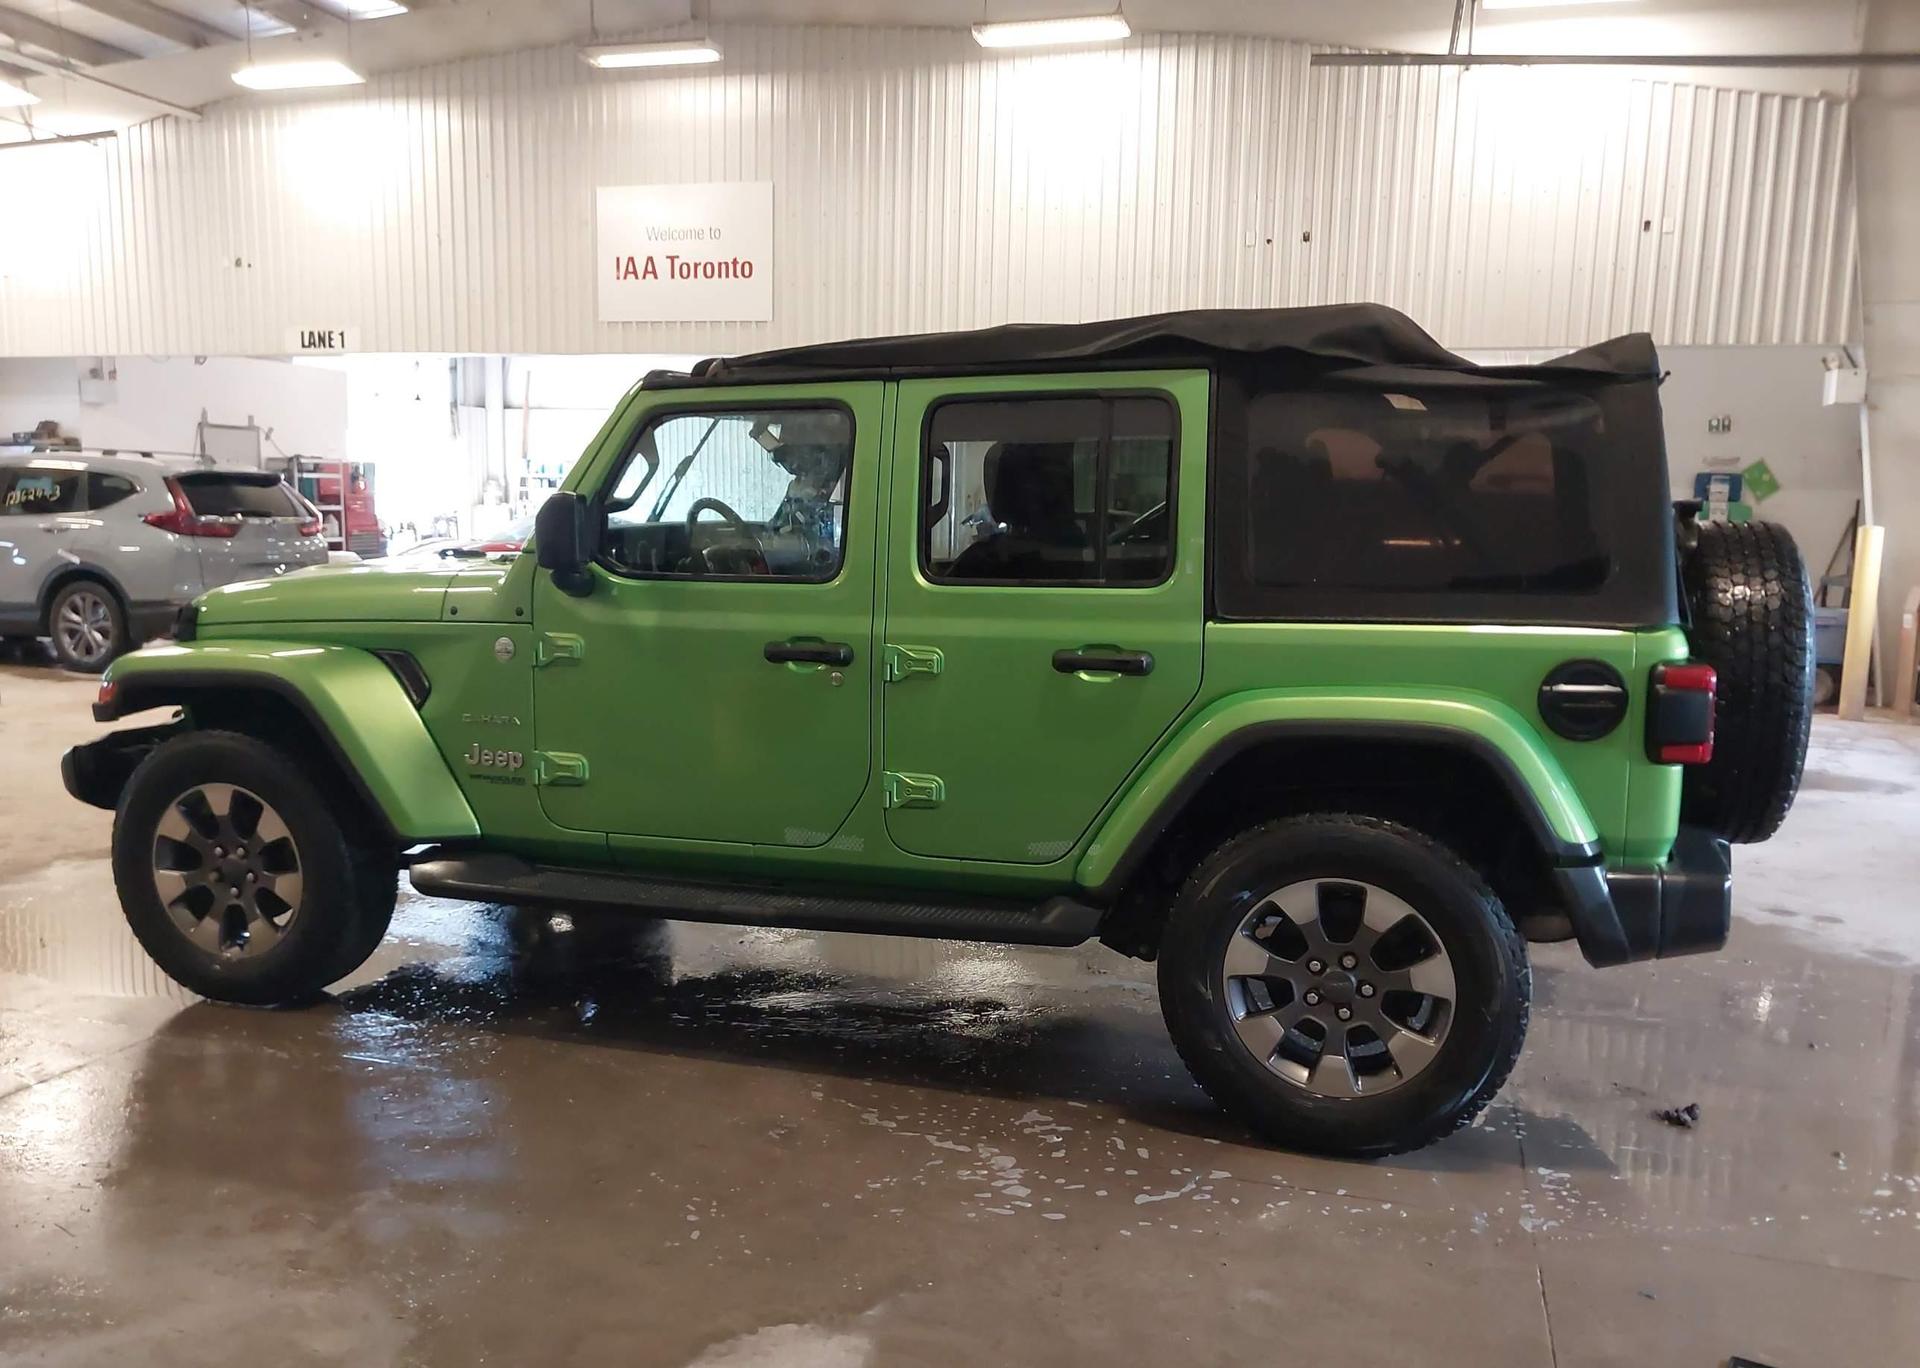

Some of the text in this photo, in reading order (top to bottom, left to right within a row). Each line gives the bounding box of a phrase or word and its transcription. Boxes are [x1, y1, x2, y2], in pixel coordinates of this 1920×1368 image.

[645, 226, 721, 241] Welcome to
[665, 255, 754, 280] Toronto
[300, 330, 345, 349] LANE 1
[463, 743, 524, 771] Jeep
